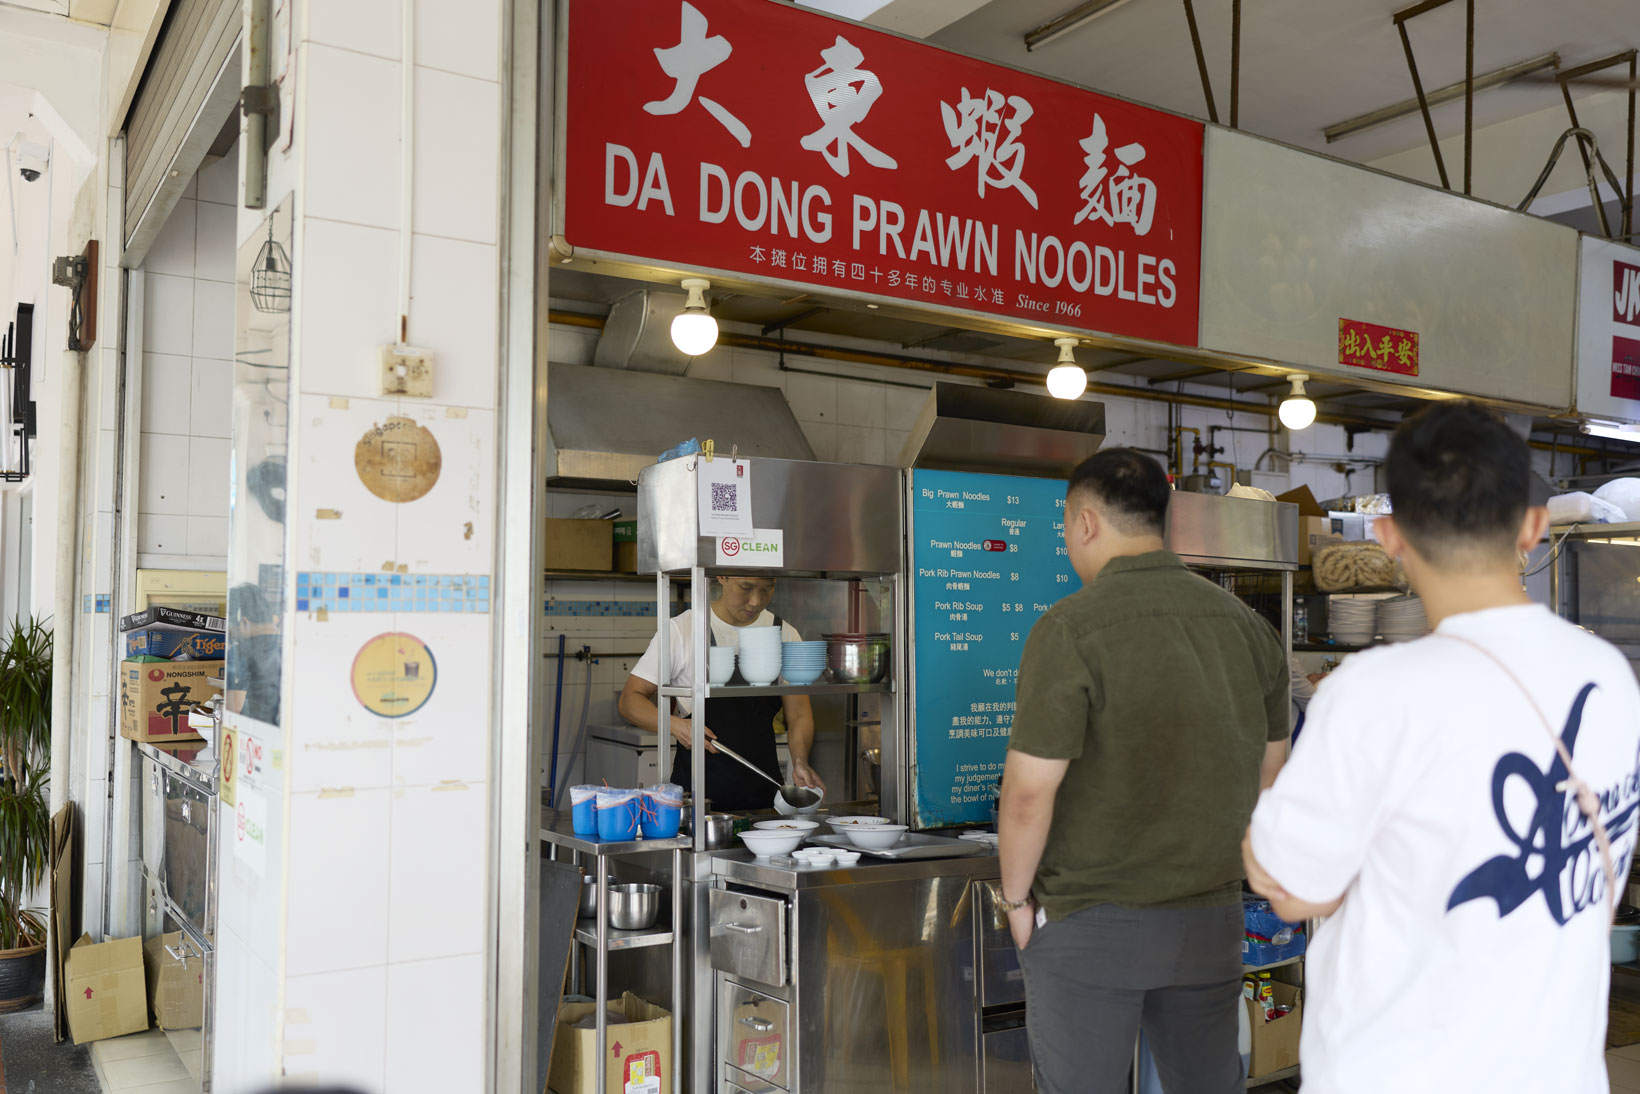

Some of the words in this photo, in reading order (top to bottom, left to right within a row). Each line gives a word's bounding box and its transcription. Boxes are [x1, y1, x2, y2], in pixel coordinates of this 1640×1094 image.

[605, 142, 674, 216] DA
[699, 161, 832, 243] DONG
[853, 193, 998, 276] PRAWN
[1015, 228, 1176, 308] NOODLES
[749, 245, 1004, 305] 本摊位拥有四十多年的专业水准
[1016, 293, 1049, 313] Since
[1055, 301, 1082, 318] 1966
[1345, 329, 1414, 367] 出入平安
[922, 488, 934, 499] Big
[937, 489, 959, 498] Prawn
[963, 491, 990, 501] Noodles
[1007, 496, 1020, 505] $13
[1001, 518, 1027, 529] Regular
[1053, 521, 1065, 531] Larg
[741, 542, 778, 552] CLEAN
[930, 539, 953, 549] Prawn
[954, 541, 981, 550] Noodles
[1009, 543, 1018, 553] $8
[1055, 546, 1068, 556] $10
[919, 568, 936, 577] Pork
[937, 569, 949, 578] Rib
[950, 569, 972, 578] Prawn
[973, 570, 1000, 580] Noodles
[1010, 572, 1019, 581] $8
[1056, 574, 1068, 583] $10
[935, 601, 951, 610] Pork
[952, 601, 964, 610] Rib
[965, 602, 983, 612] Soup
[1002, 603, 1011, 612] $5
[1015, 603, 1024, 612] $8
[1033, 602, 1049, 612] Pork
[166, 610, 191, 620] GUINNESS
[934, 632, 951, 641] Pork
[952, 632, 964, 641] Tail
[965, 632, 983, 643] Soup
[1010, 632, 1019, 641] $5
[195, 638, 225, 654] Tiger
[983, 669, 995, 677] We
[995, 668, 1013, 677] don't
[156, 682, 202, 735] 辛
[960, 763, 978, 772] strive
[980, 762, 987, 771] to
[988, 761, 997, 770] do
[955, 775, 965, 784] my
[951, 786, 962, 795] my
[963, 783, 986, 792] diner's
[950, 795, 962, 804] the
[963, 793, 979, 803] bowl
[980, 793, 987, 802] of
